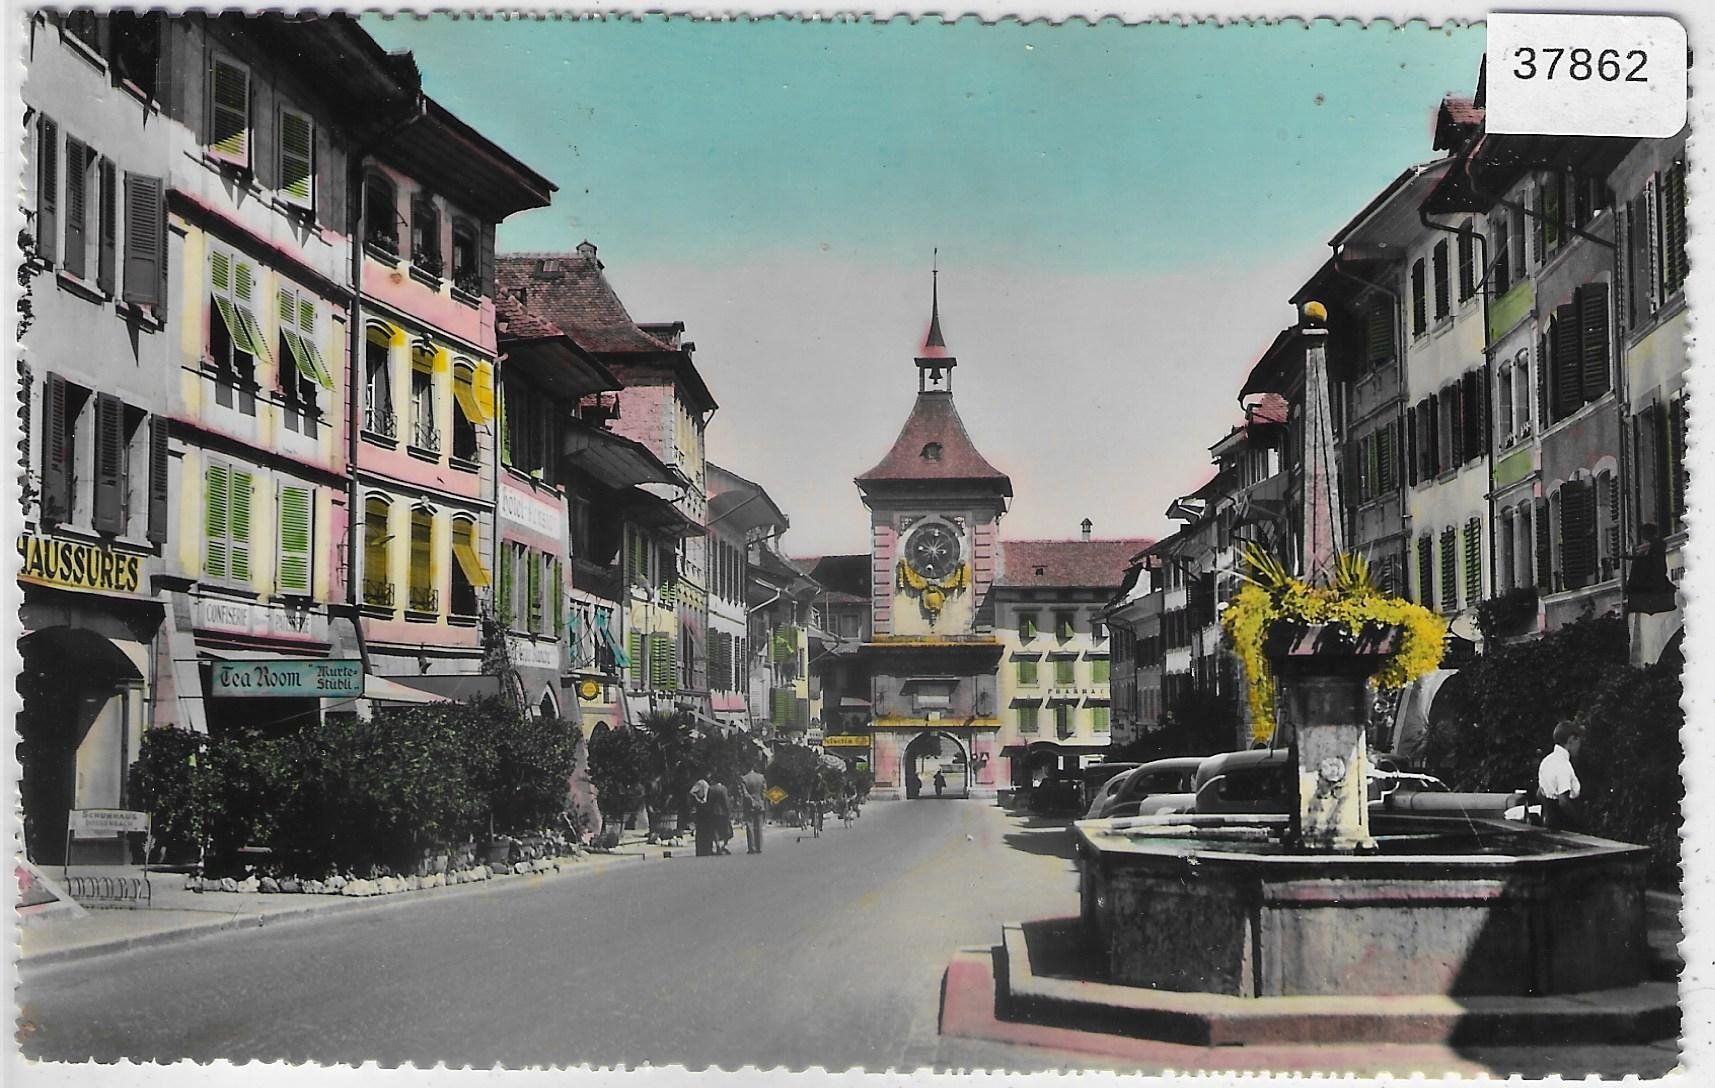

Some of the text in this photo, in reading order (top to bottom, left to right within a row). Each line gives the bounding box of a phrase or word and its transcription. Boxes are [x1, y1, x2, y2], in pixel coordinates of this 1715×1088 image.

[206, 603, 248, 626] CONFISERIE
[220, 666, 302, 688] Tea Room
